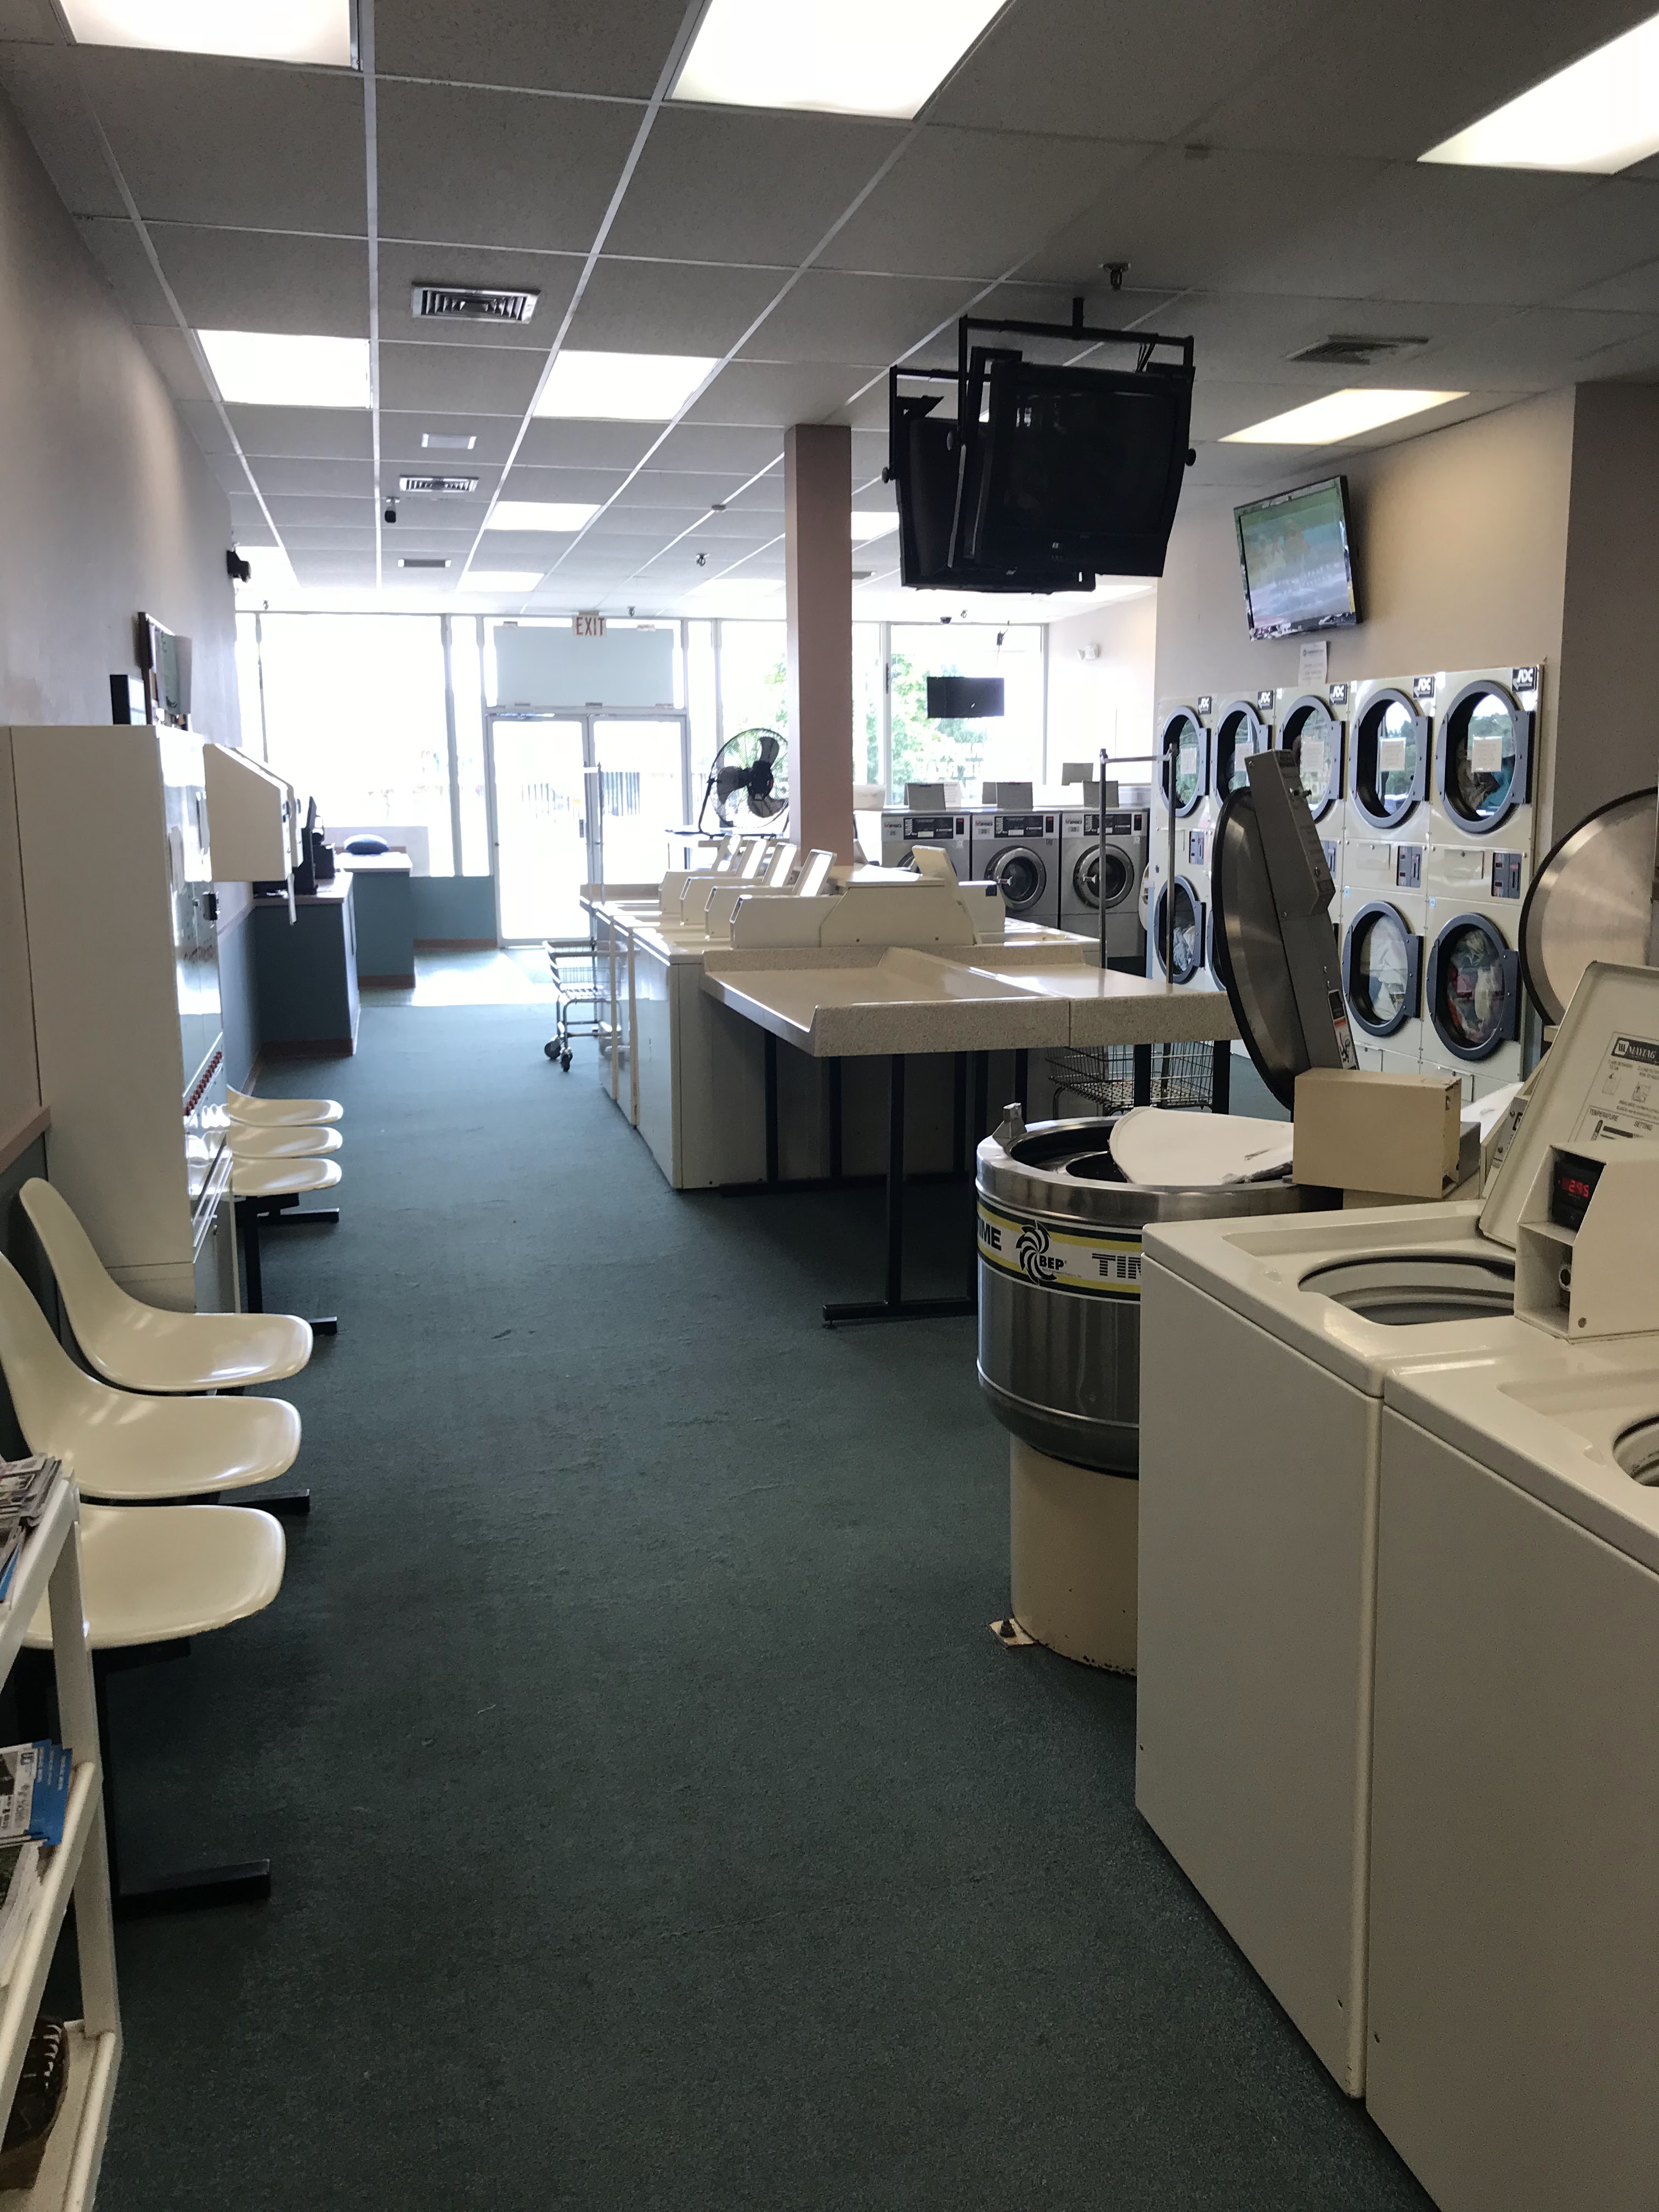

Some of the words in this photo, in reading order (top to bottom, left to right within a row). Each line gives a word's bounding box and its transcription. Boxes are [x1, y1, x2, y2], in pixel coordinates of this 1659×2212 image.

[576, 617, 605, 636] EXIT
[1516, 668, 1534, 684] ADC
[1418, 678, 1431, 691] ADC
[1627, 1045, 1656, 1059] MAYTAG
[1589, 1108, 1619, 1121] TEMPERATURE
[1633, 1121, 1653, 1131] SETTING
[979, 1218, 1002, 1251] IME
[1039, 1255, 1064, 1270] BEP
